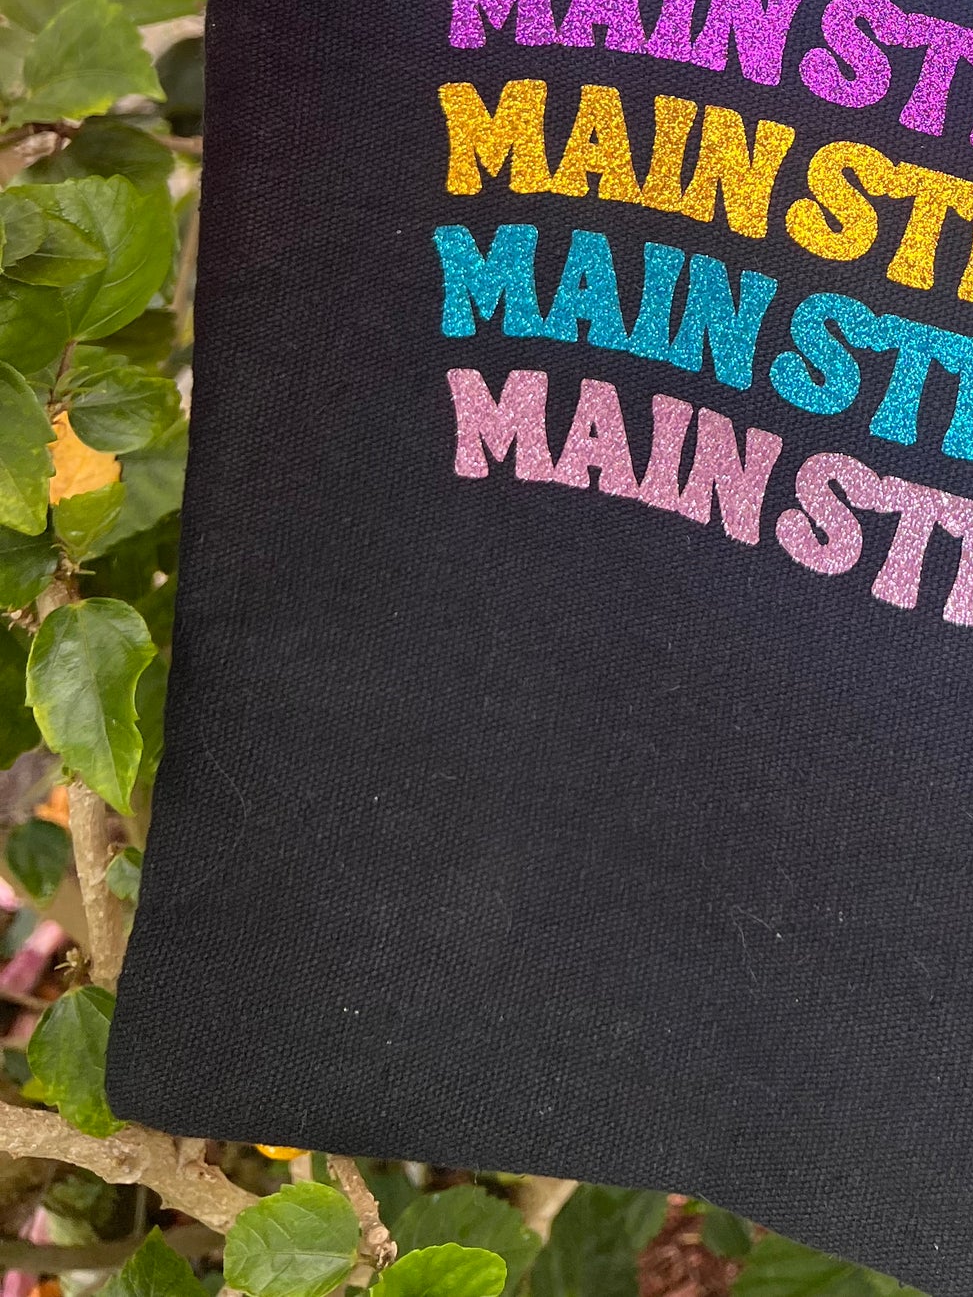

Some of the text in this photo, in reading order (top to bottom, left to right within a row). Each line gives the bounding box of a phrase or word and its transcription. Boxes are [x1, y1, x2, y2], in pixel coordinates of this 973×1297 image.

[438, 79, 796, 239] MAIN
[433, 224, 779, 391] MAIN
[446, 368, 784, 546] MAIN
